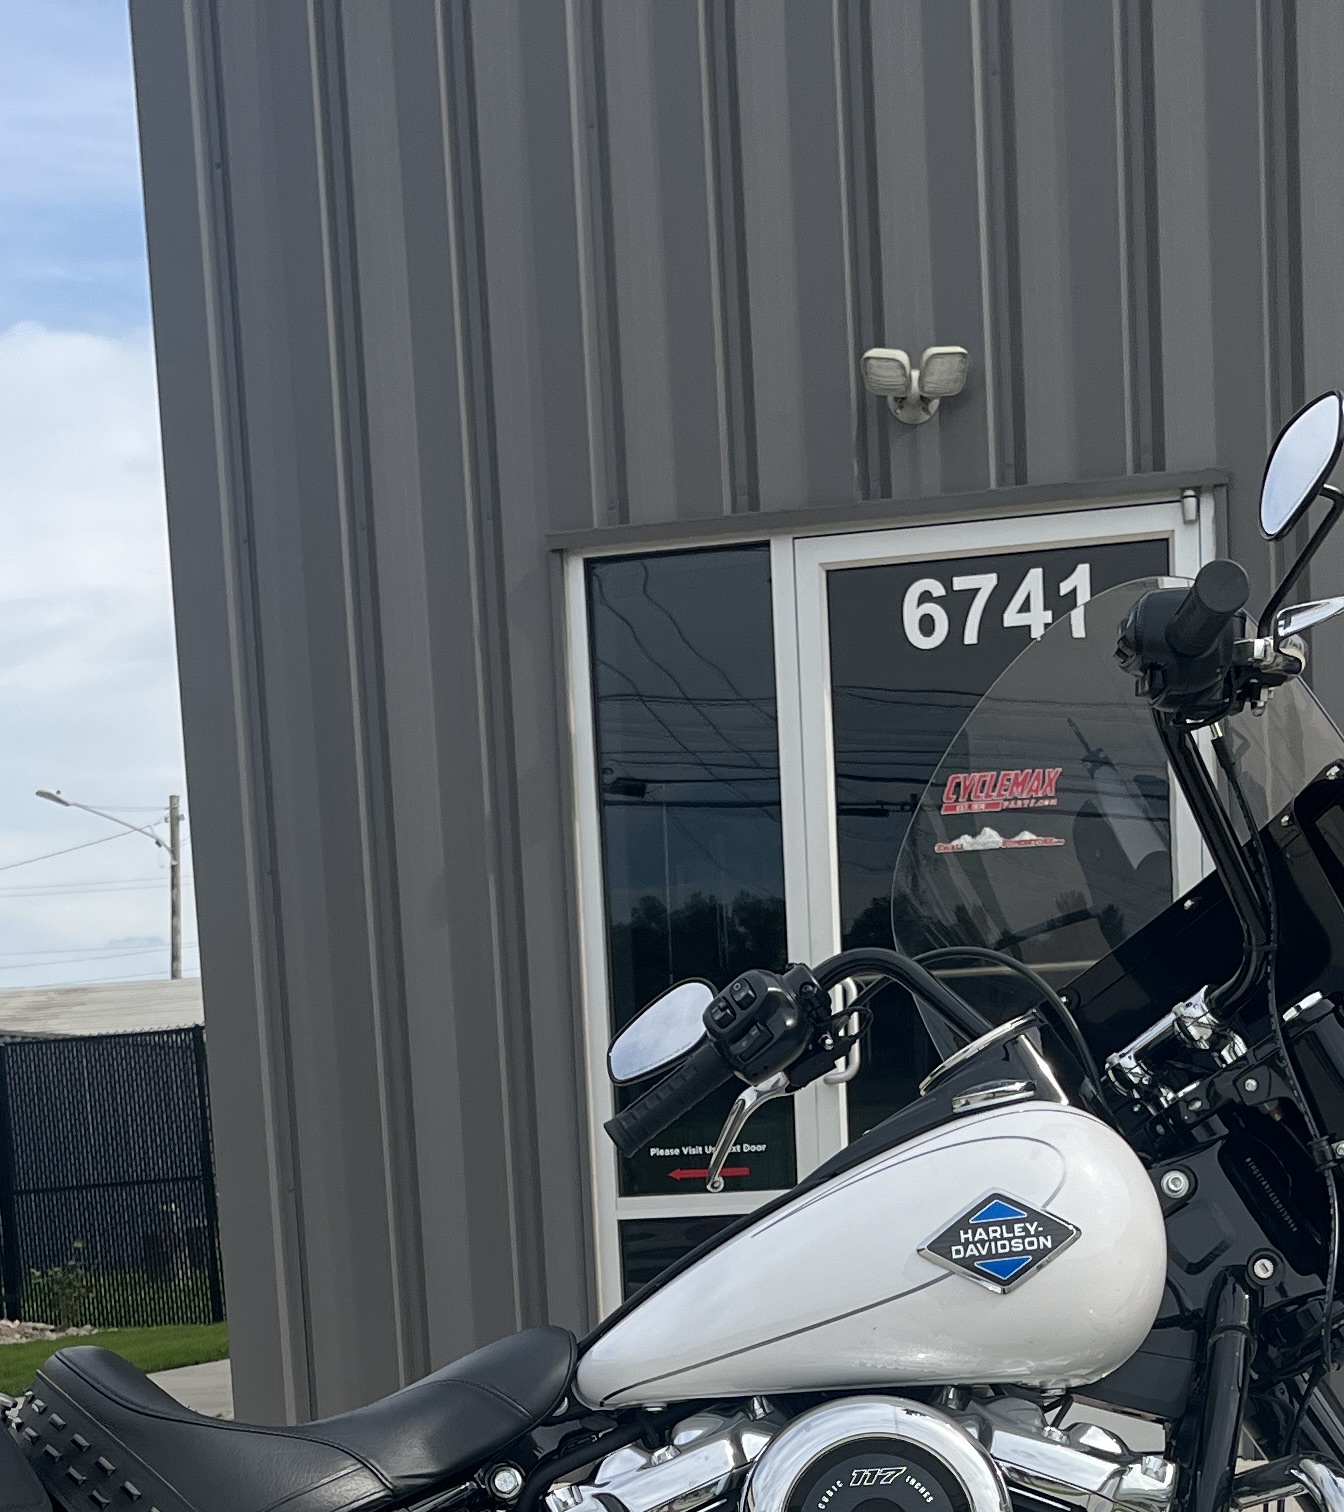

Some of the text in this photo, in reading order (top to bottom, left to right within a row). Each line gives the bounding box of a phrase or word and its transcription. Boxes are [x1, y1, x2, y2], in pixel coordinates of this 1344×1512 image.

[902, 563, 1091, 650] 6741
[942, 767, 1063, 802] CYCLEMAX
[649, 1147, 680, 1156] Please
[681, 1145, 703, 1155] Visit
[742, 1143, 766, 1152] Door
[959, 1221, 1044, 1243] HARLEY-
[951, 1235, 1053, 1259] DAVIDSON
[817, 1466, 934, 1510] CUBIC 117 INCHES
